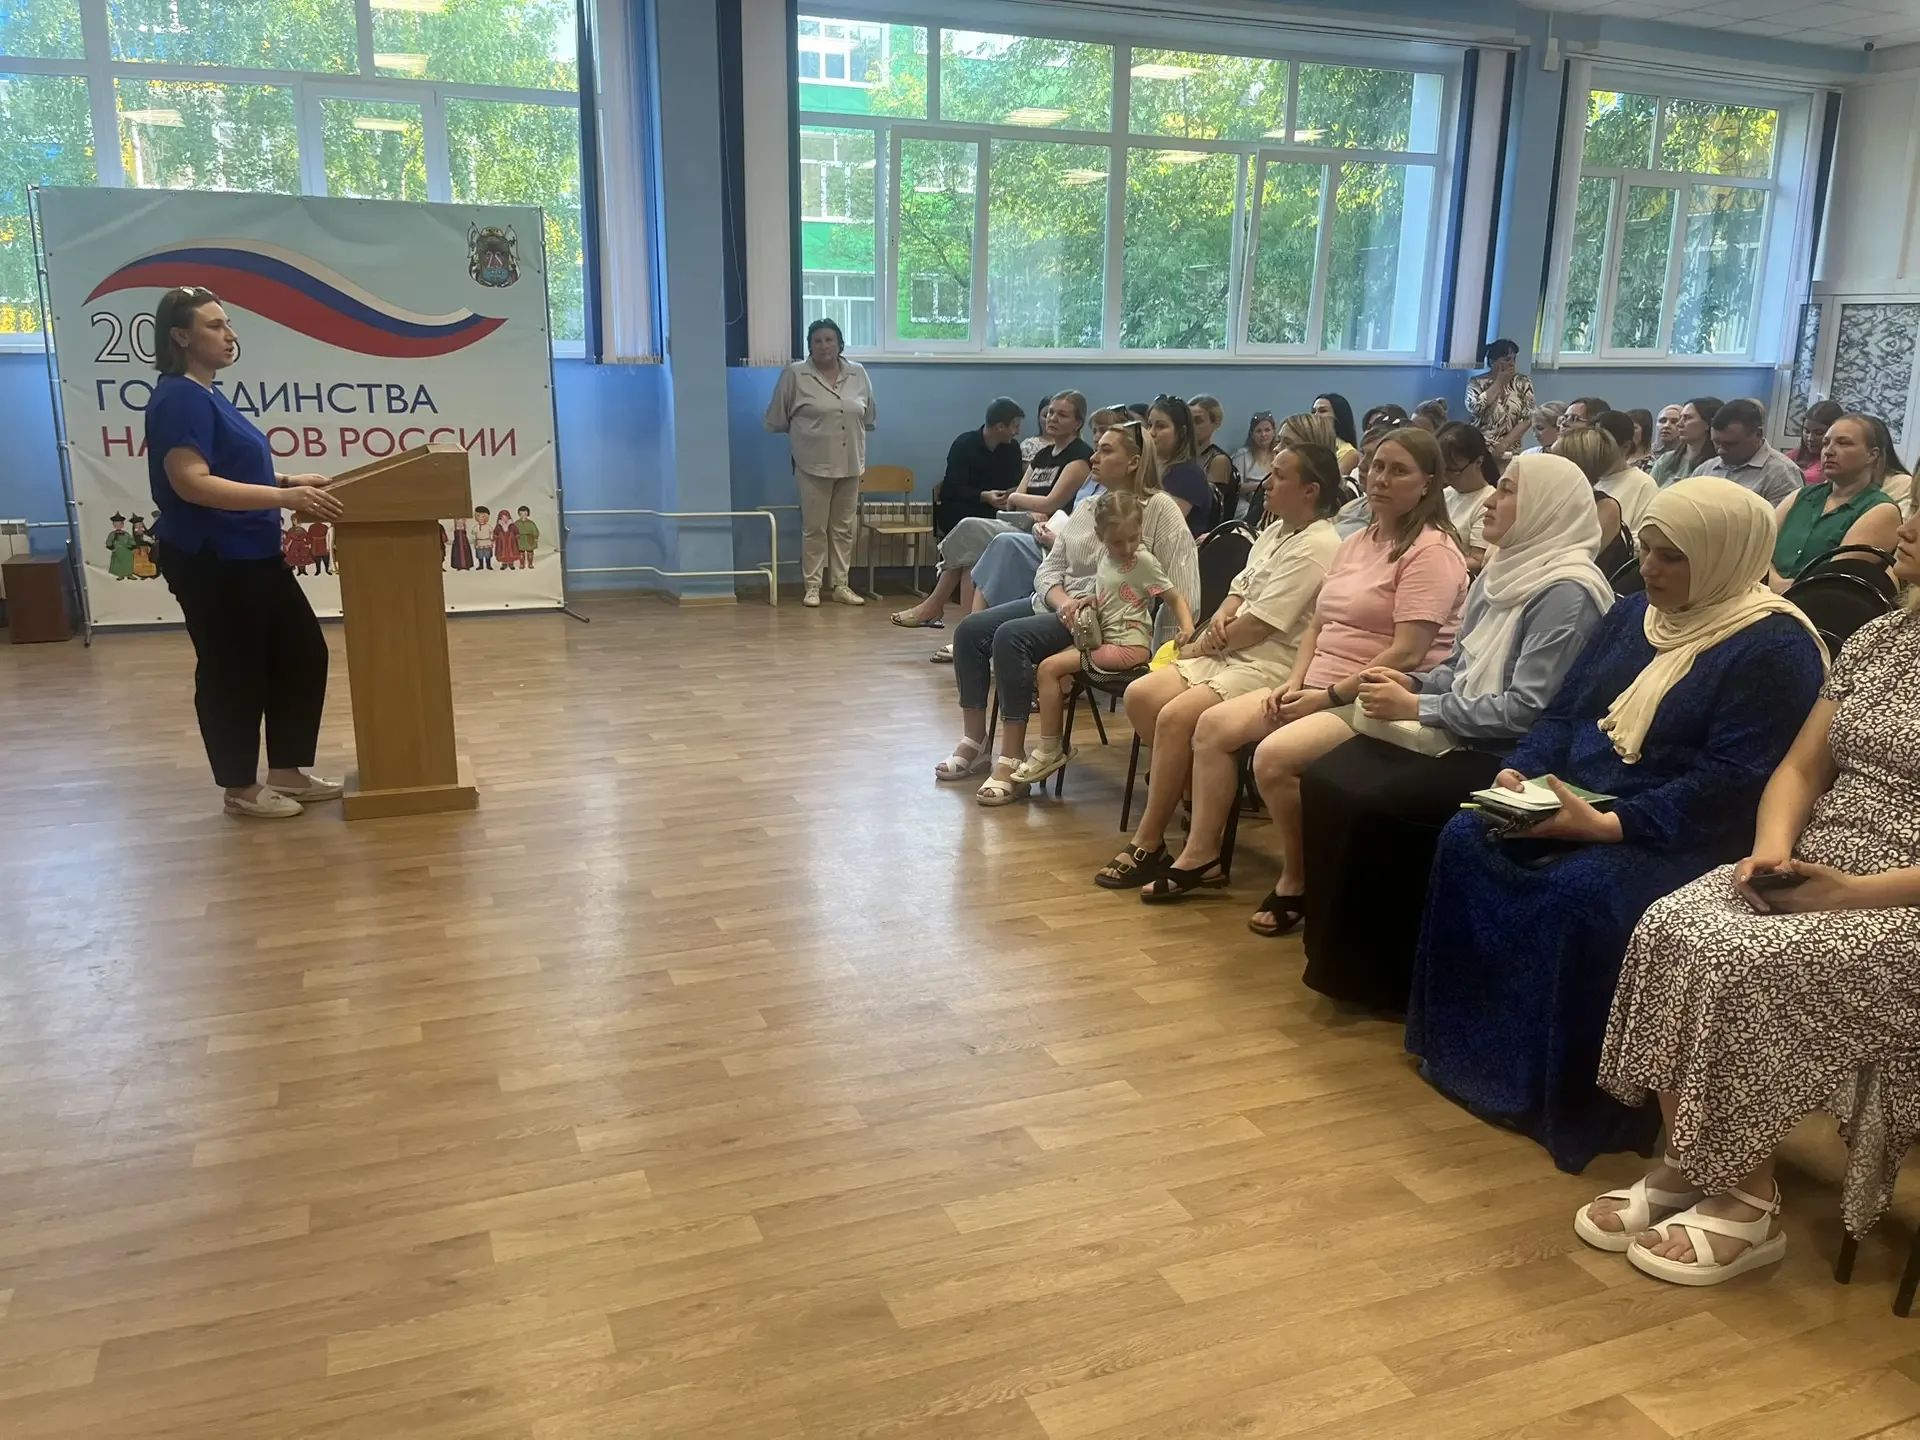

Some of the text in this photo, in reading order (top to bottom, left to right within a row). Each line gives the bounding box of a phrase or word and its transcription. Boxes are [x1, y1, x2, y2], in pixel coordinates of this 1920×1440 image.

[91, 311, 241, 363] 20
[96, 379, 439, 417] ГО ДИНСТВА
